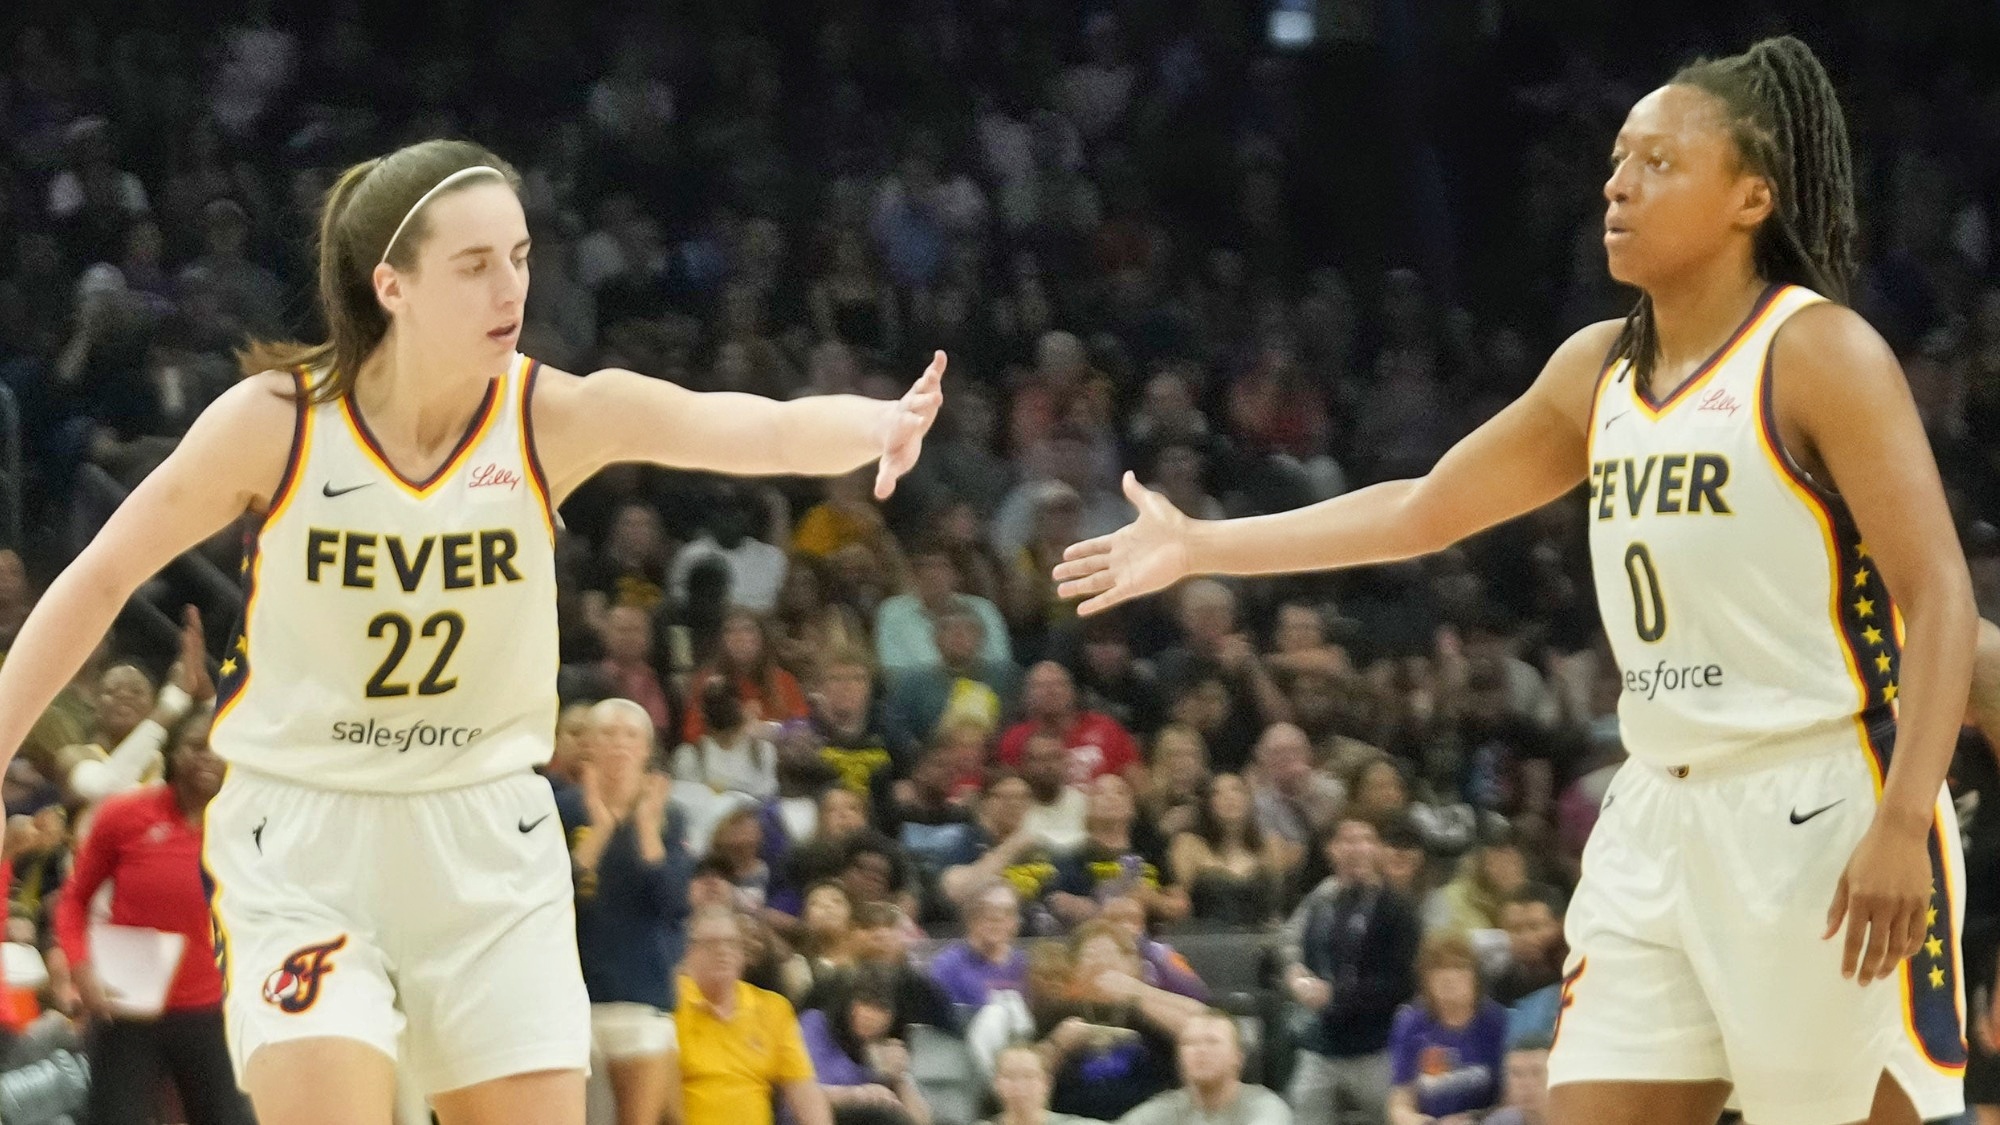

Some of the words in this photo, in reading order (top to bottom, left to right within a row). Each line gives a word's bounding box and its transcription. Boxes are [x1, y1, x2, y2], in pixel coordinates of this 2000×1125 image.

[1698, 388, 1742, 417] Lilly
[469, 463, 521, 491] Lilly
[306, 527, 525, 593] FEVER
[1624, 539, 1667, 643] 0
[365, 610, 465, 698] 22
